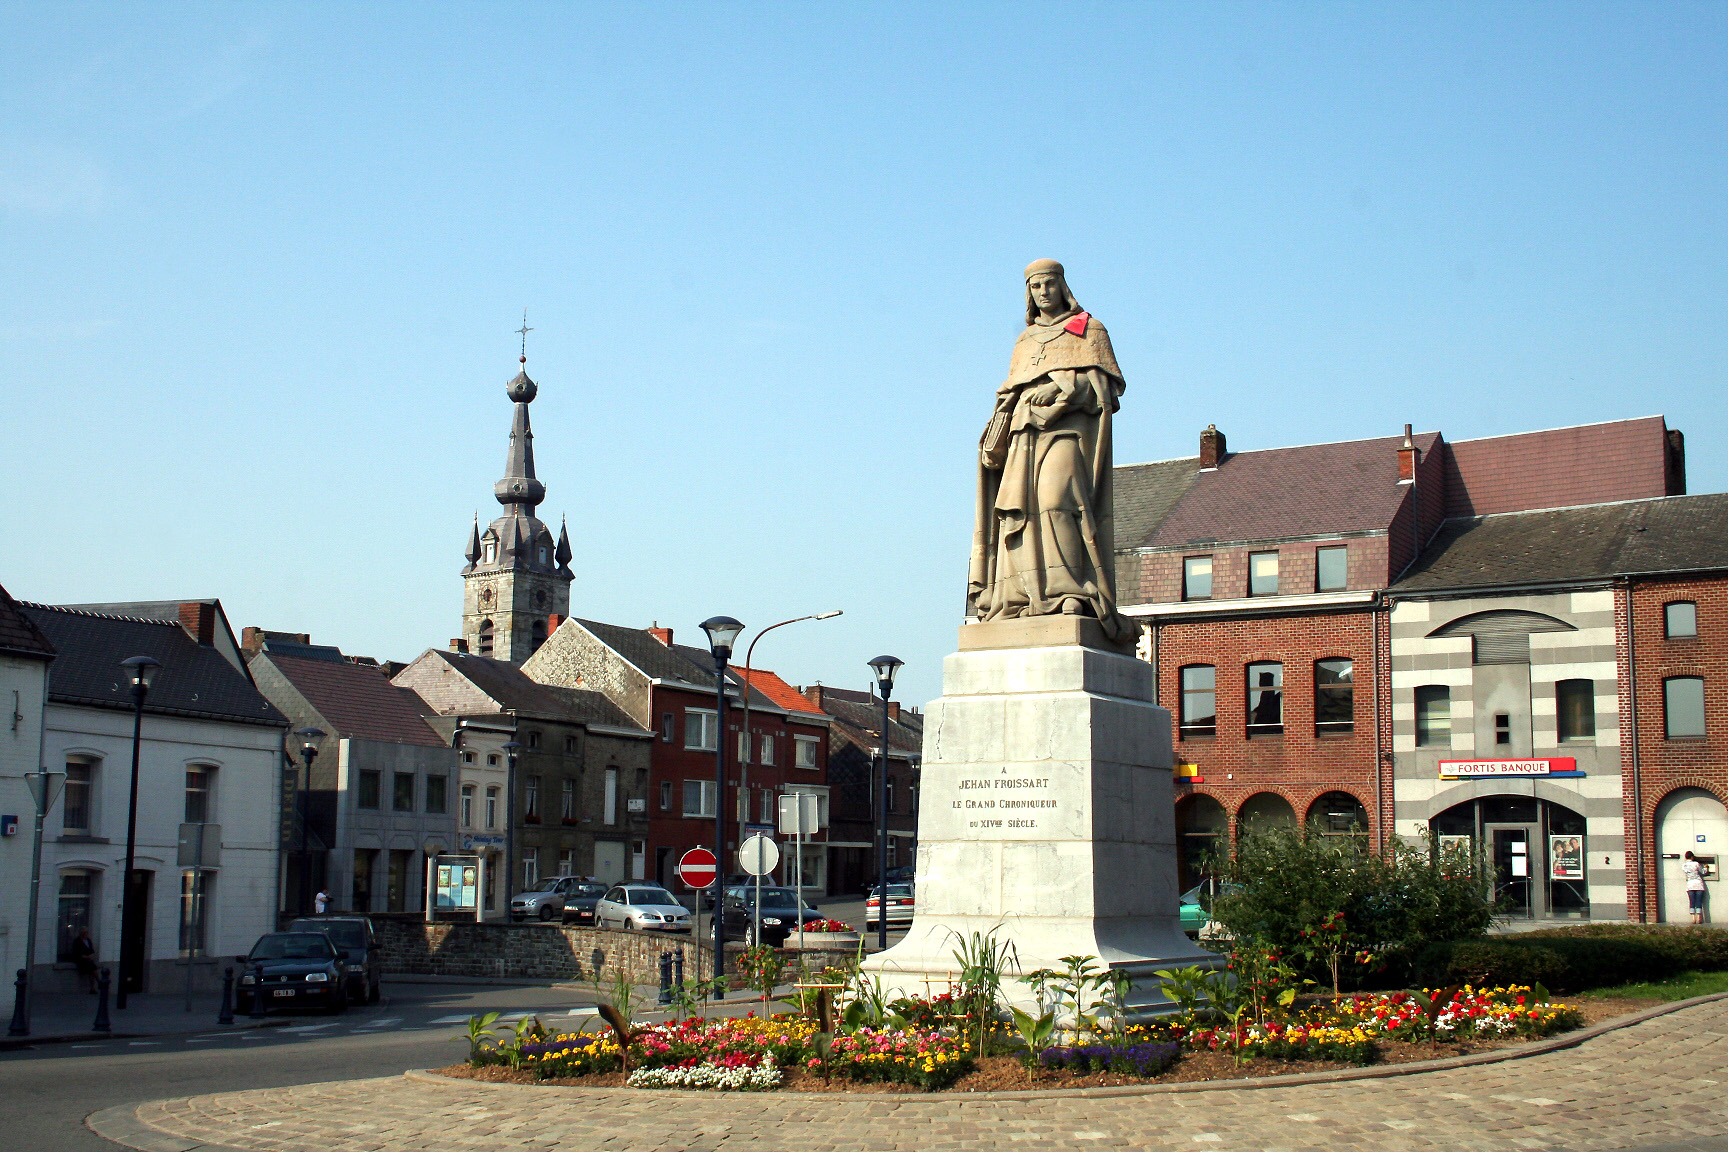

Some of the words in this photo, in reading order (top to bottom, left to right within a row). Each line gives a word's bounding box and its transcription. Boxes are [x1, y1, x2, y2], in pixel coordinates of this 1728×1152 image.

[1001, 766, 1007, 774] A
[1458, 764, 1496, 773] FORTIS
[1501, 763, 1545, 773] BANQUE
[959, 779, 991, 789] JEHAN
[994, 778, 1049, 789] FROISSART
[952, 800, 962, 809] LE
[965, 799, 995, 809] GRAND
[999, 799, 1058, 809] CHRONIQUEUR
[1007, 817, 1038, 828] SIÈCLE.
